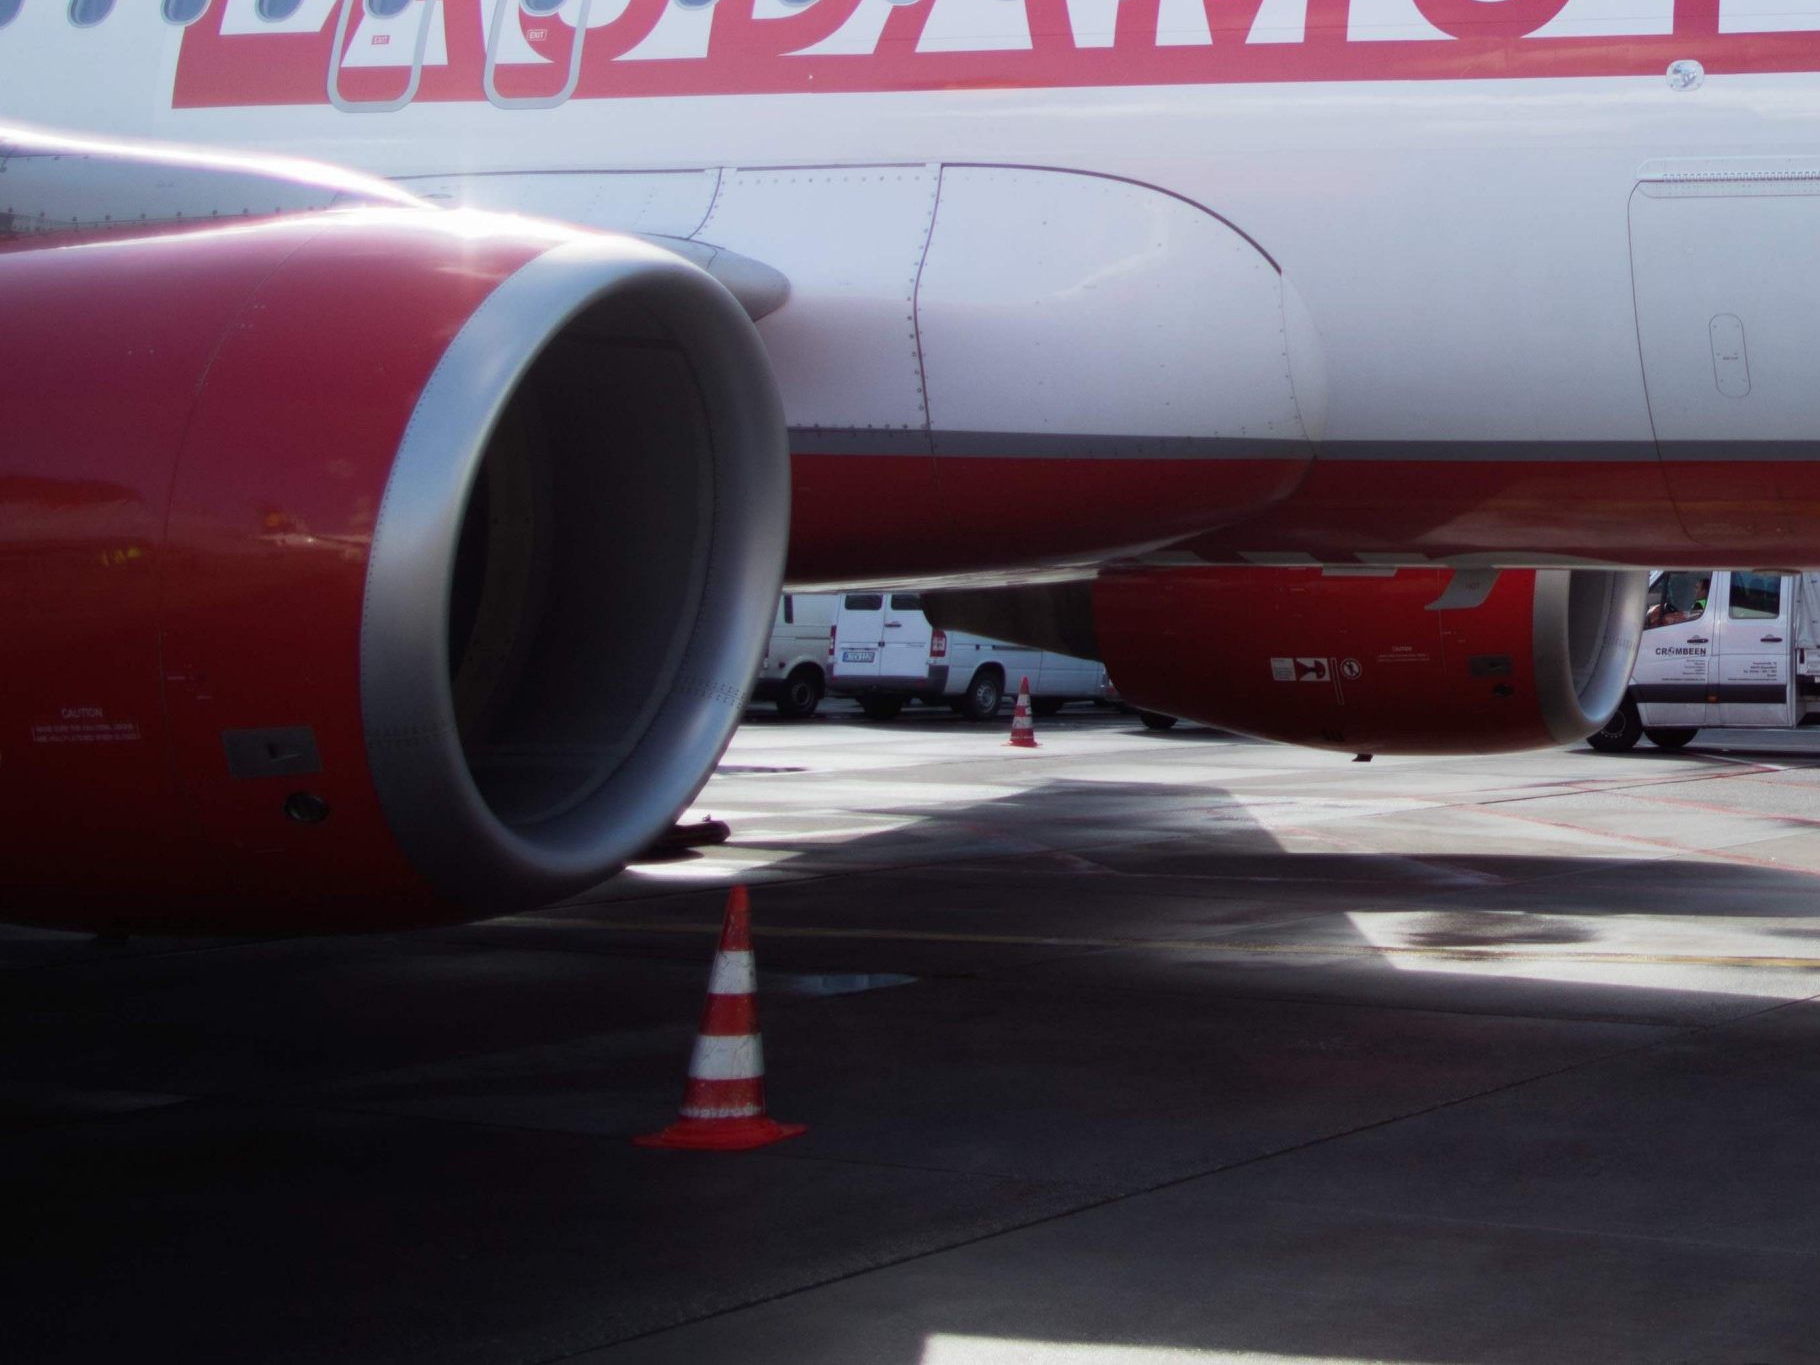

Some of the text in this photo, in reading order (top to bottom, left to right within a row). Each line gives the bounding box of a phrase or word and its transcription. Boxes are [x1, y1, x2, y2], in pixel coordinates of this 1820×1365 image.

[373, 35, 388, 44] EXIT
[529, 31, 545, 40] EXIT
[61, 707, 104, 719] CAUTION
